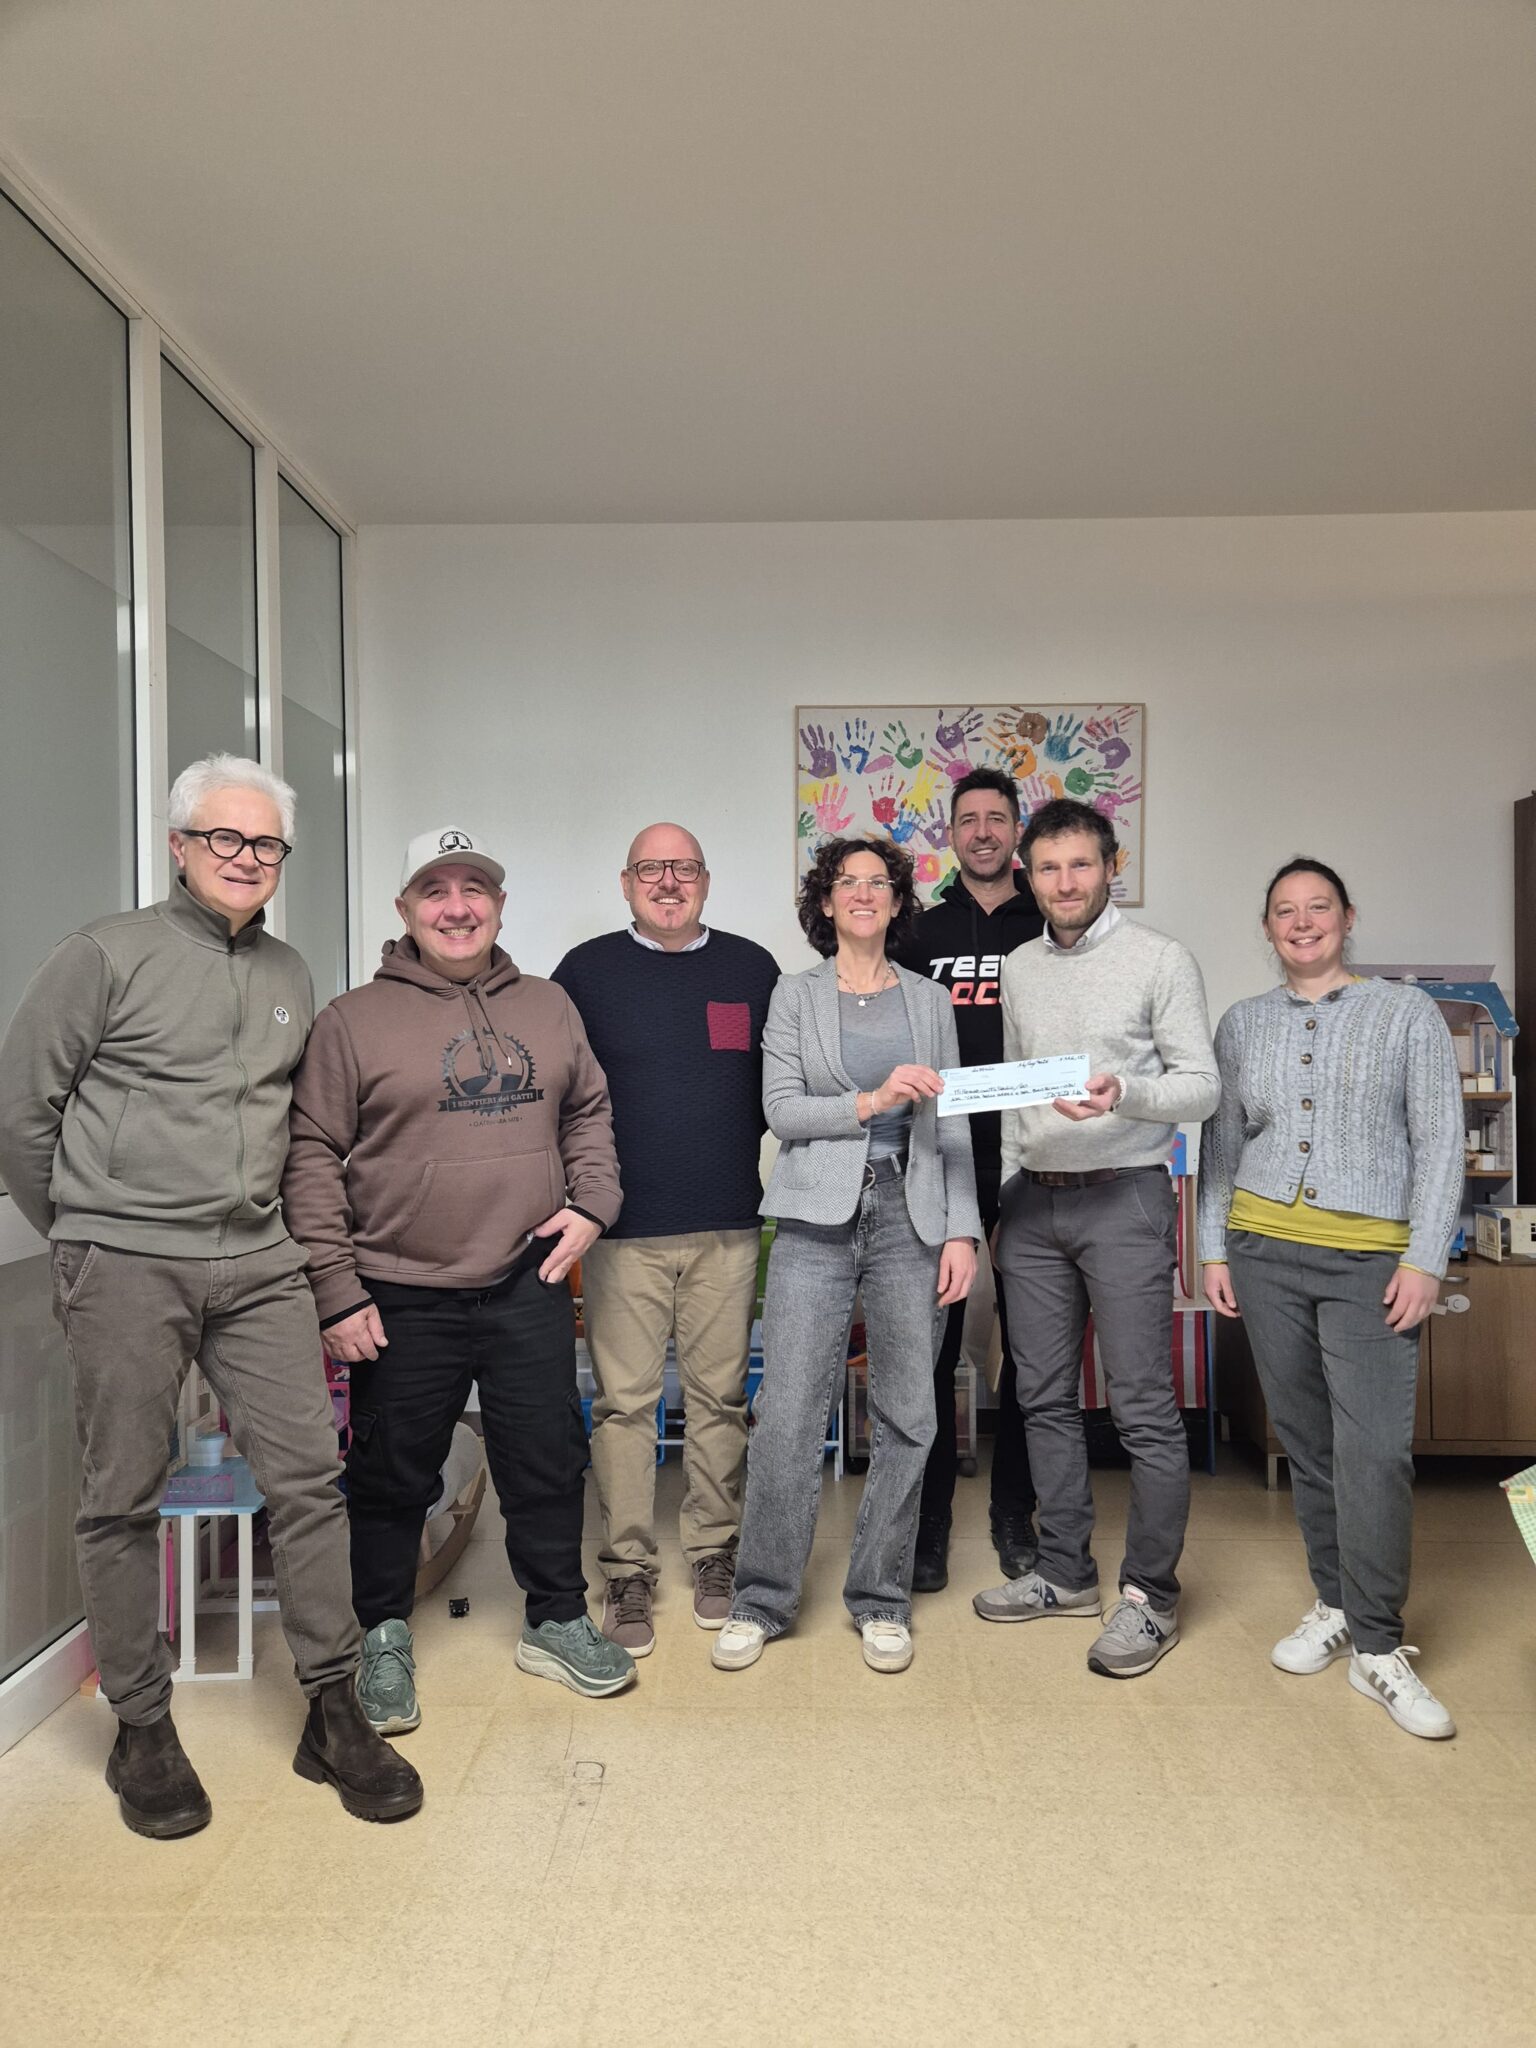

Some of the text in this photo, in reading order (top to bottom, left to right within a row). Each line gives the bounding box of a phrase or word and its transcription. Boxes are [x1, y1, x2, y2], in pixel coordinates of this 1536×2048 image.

[458, 1096, 497, 1107] SENTIERI
[498, 1095, 509, 1103] dei
[510, 1092, 533, 1101] GATTI
